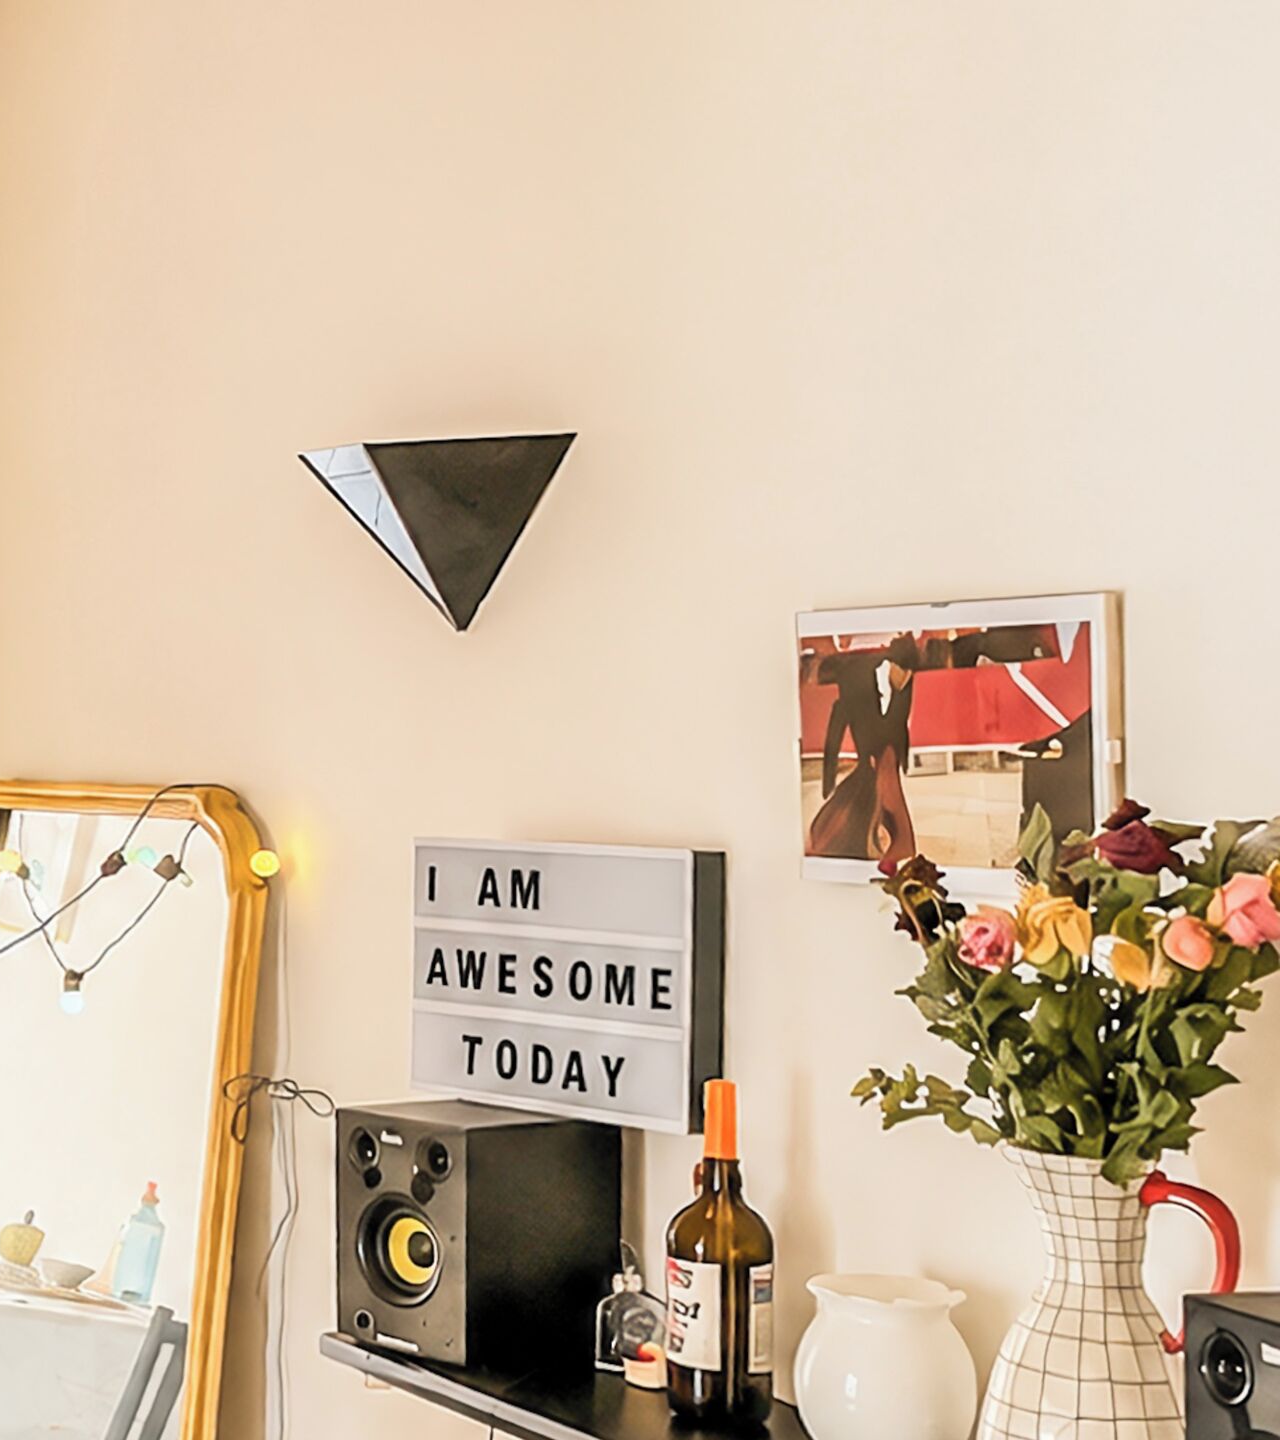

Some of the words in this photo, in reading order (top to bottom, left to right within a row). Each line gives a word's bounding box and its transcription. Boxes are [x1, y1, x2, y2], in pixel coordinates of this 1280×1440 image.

[428, 865, 437, 902] I
[478, 868, 540, 910] AM
[427, 948, 671, 1009] AWESOME
[463, 1035, 624, 1097] TODAY
